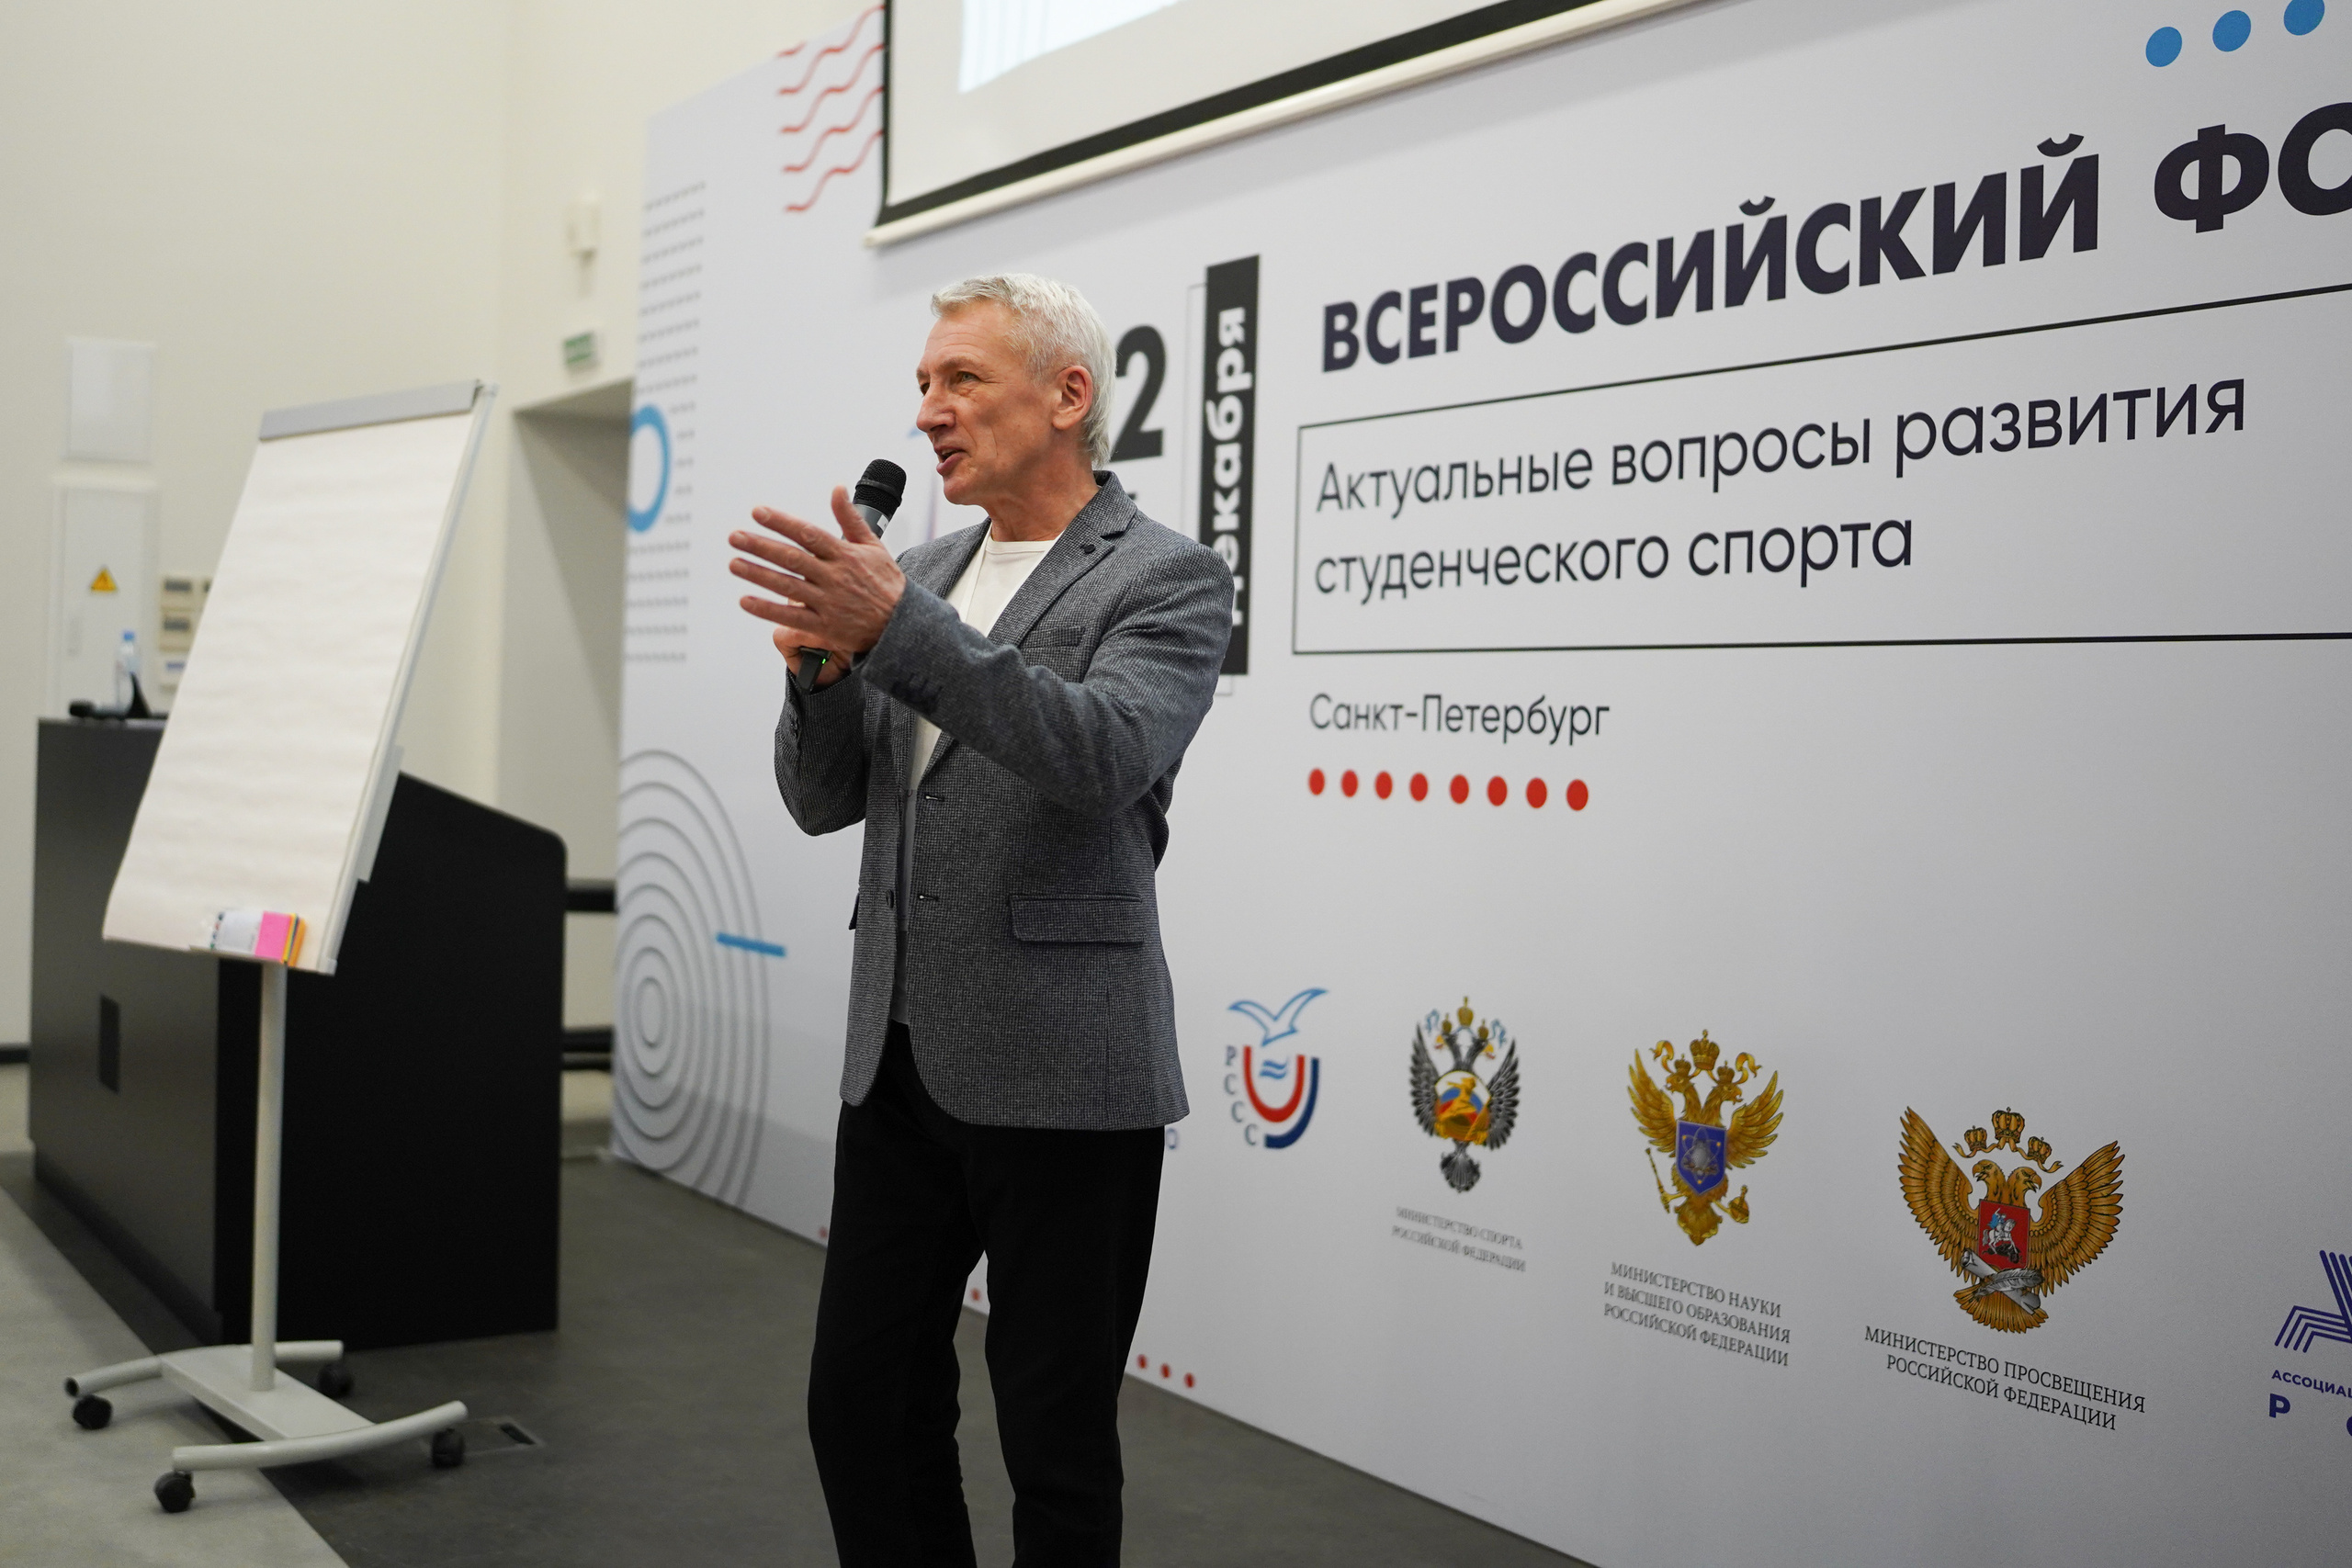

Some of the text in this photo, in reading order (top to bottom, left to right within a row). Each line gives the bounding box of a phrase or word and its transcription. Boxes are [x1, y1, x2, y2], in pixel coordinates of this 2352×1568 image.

[1323, 133, 2099, 373] ВСЕРОССИЙСКИЙ
[1316, 378, 2245, 519] Актуальные вопросы развития
[1314, 518, 1912, 605] студенческого спорта
[1309, 692, 1611, 747] Санкт-Петербург
[1604, 1281, 1791, 1344] И ВЫСШЕГО ОБРАЗОВАНИЯ
[1611, 1261, 1781, 1318] МИНИСТЕРСТВО НАУКИ
[1604, 1303, 1790, 1367] РОССИЙСКОЙ ФЕДЕРАЦИИ
[1864, 1325, 2146, 1413] МИНИСТЕРСТВО ПРОСВЕЩЕНИЯ
[1886, 1354, 2117, 1431] РОССИЙСКОЙ ФЕДЕРАЦИИ
